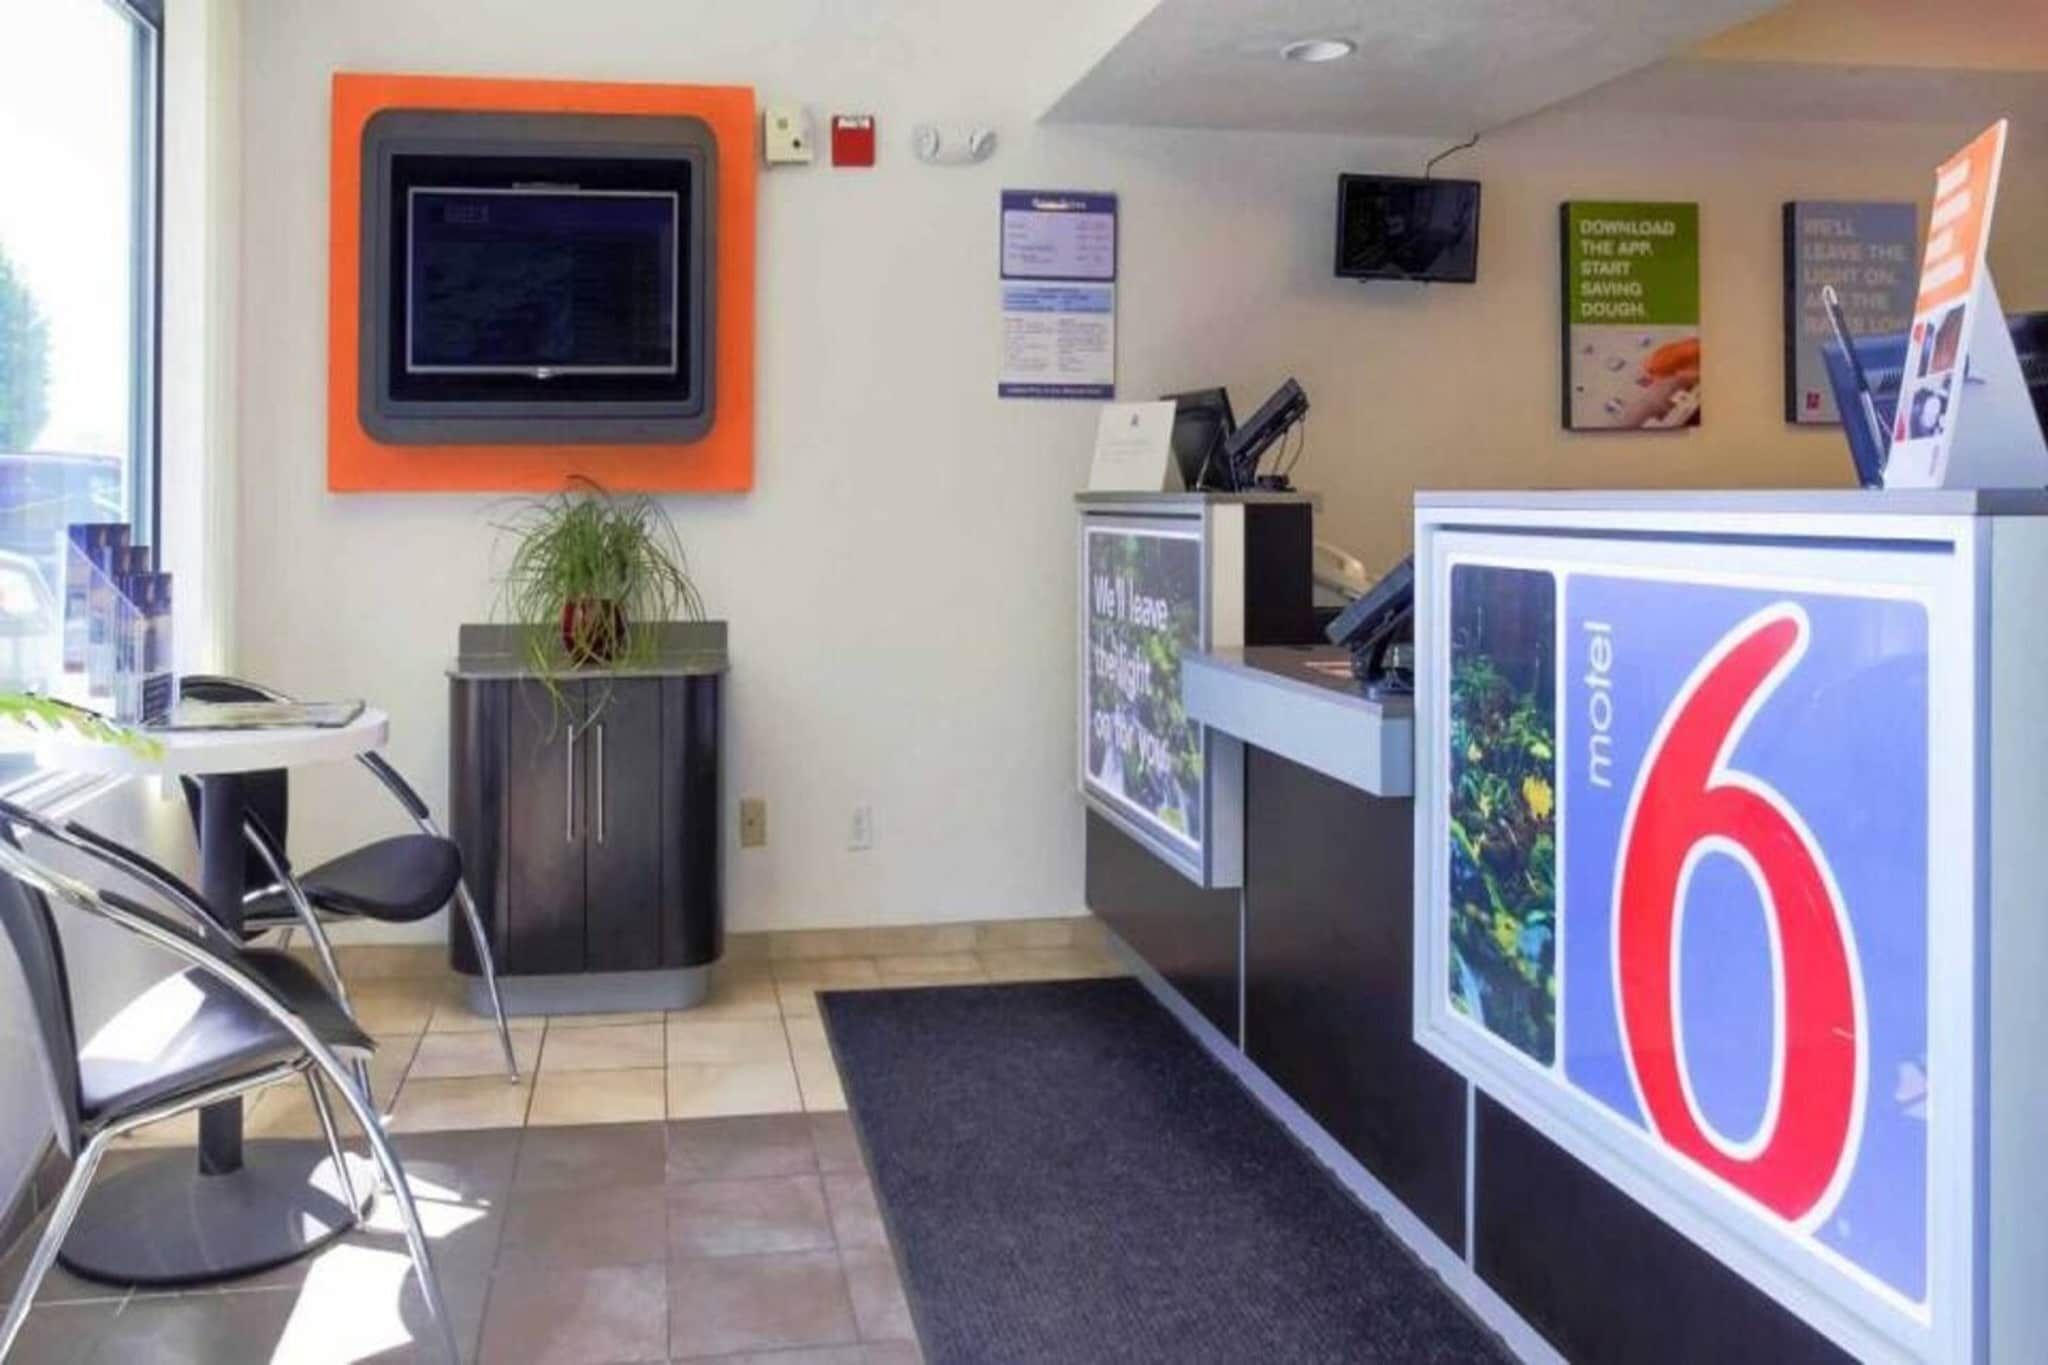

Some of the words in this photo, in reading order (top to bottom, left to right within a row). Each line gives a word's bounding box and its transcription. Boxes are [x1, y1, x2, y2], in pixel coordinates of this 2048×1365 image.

[1581, 219, 1676, 236] DOWNLOAD
[1581, 239, 1615, 256] THE
[1867, 243, 1908, 261] THE
[1581, 260, 1631, 276] START
[1581, 280, 1644, 298] SAVING
[1129, 576, 1168, 632] leave
[1583, 620, 1613, 788] motel
[1612, 602, 1868, 1237] 6
